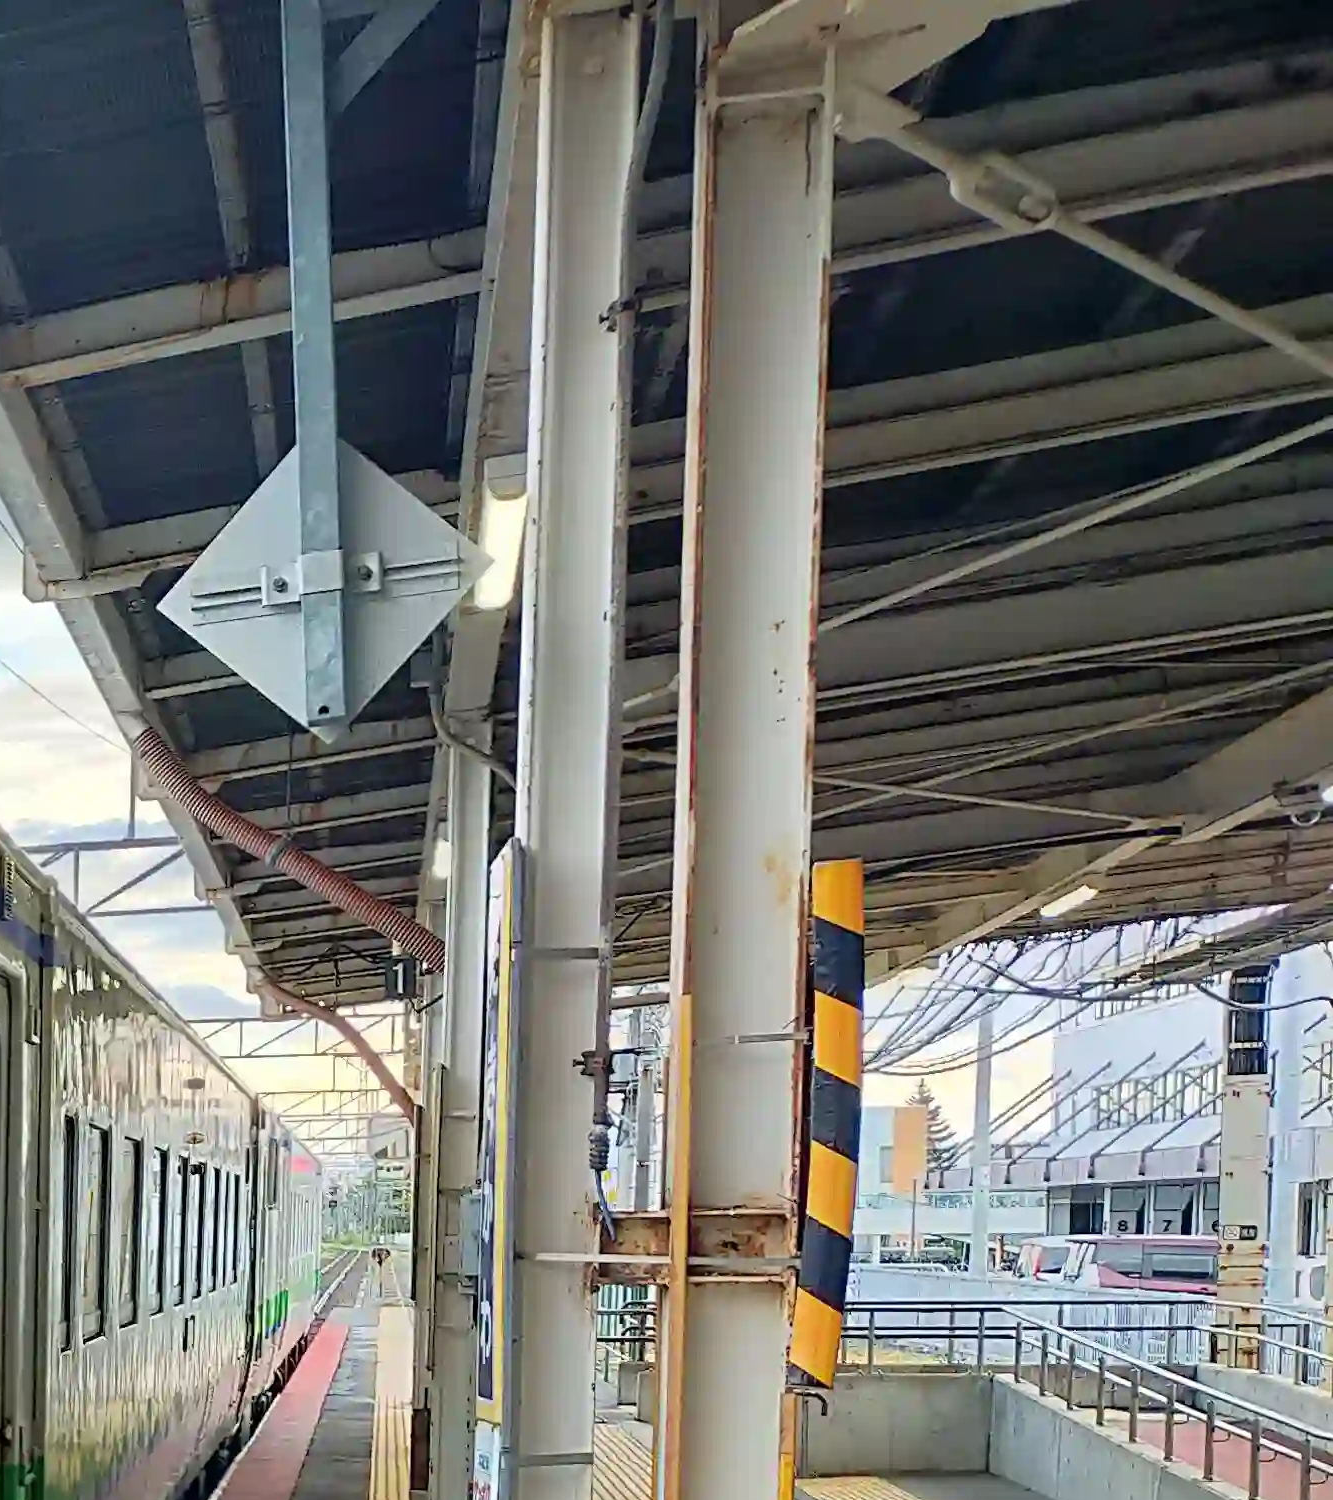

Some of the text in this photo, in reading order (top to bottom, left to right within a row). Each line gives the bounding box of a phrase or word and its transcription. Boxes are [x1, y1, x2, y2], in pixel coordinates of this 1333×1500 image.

[392, 962, 404, 994] 1
[1117, 1219, 1129, 1232] 8
[1162, 1219, 1173, 1232] 7
